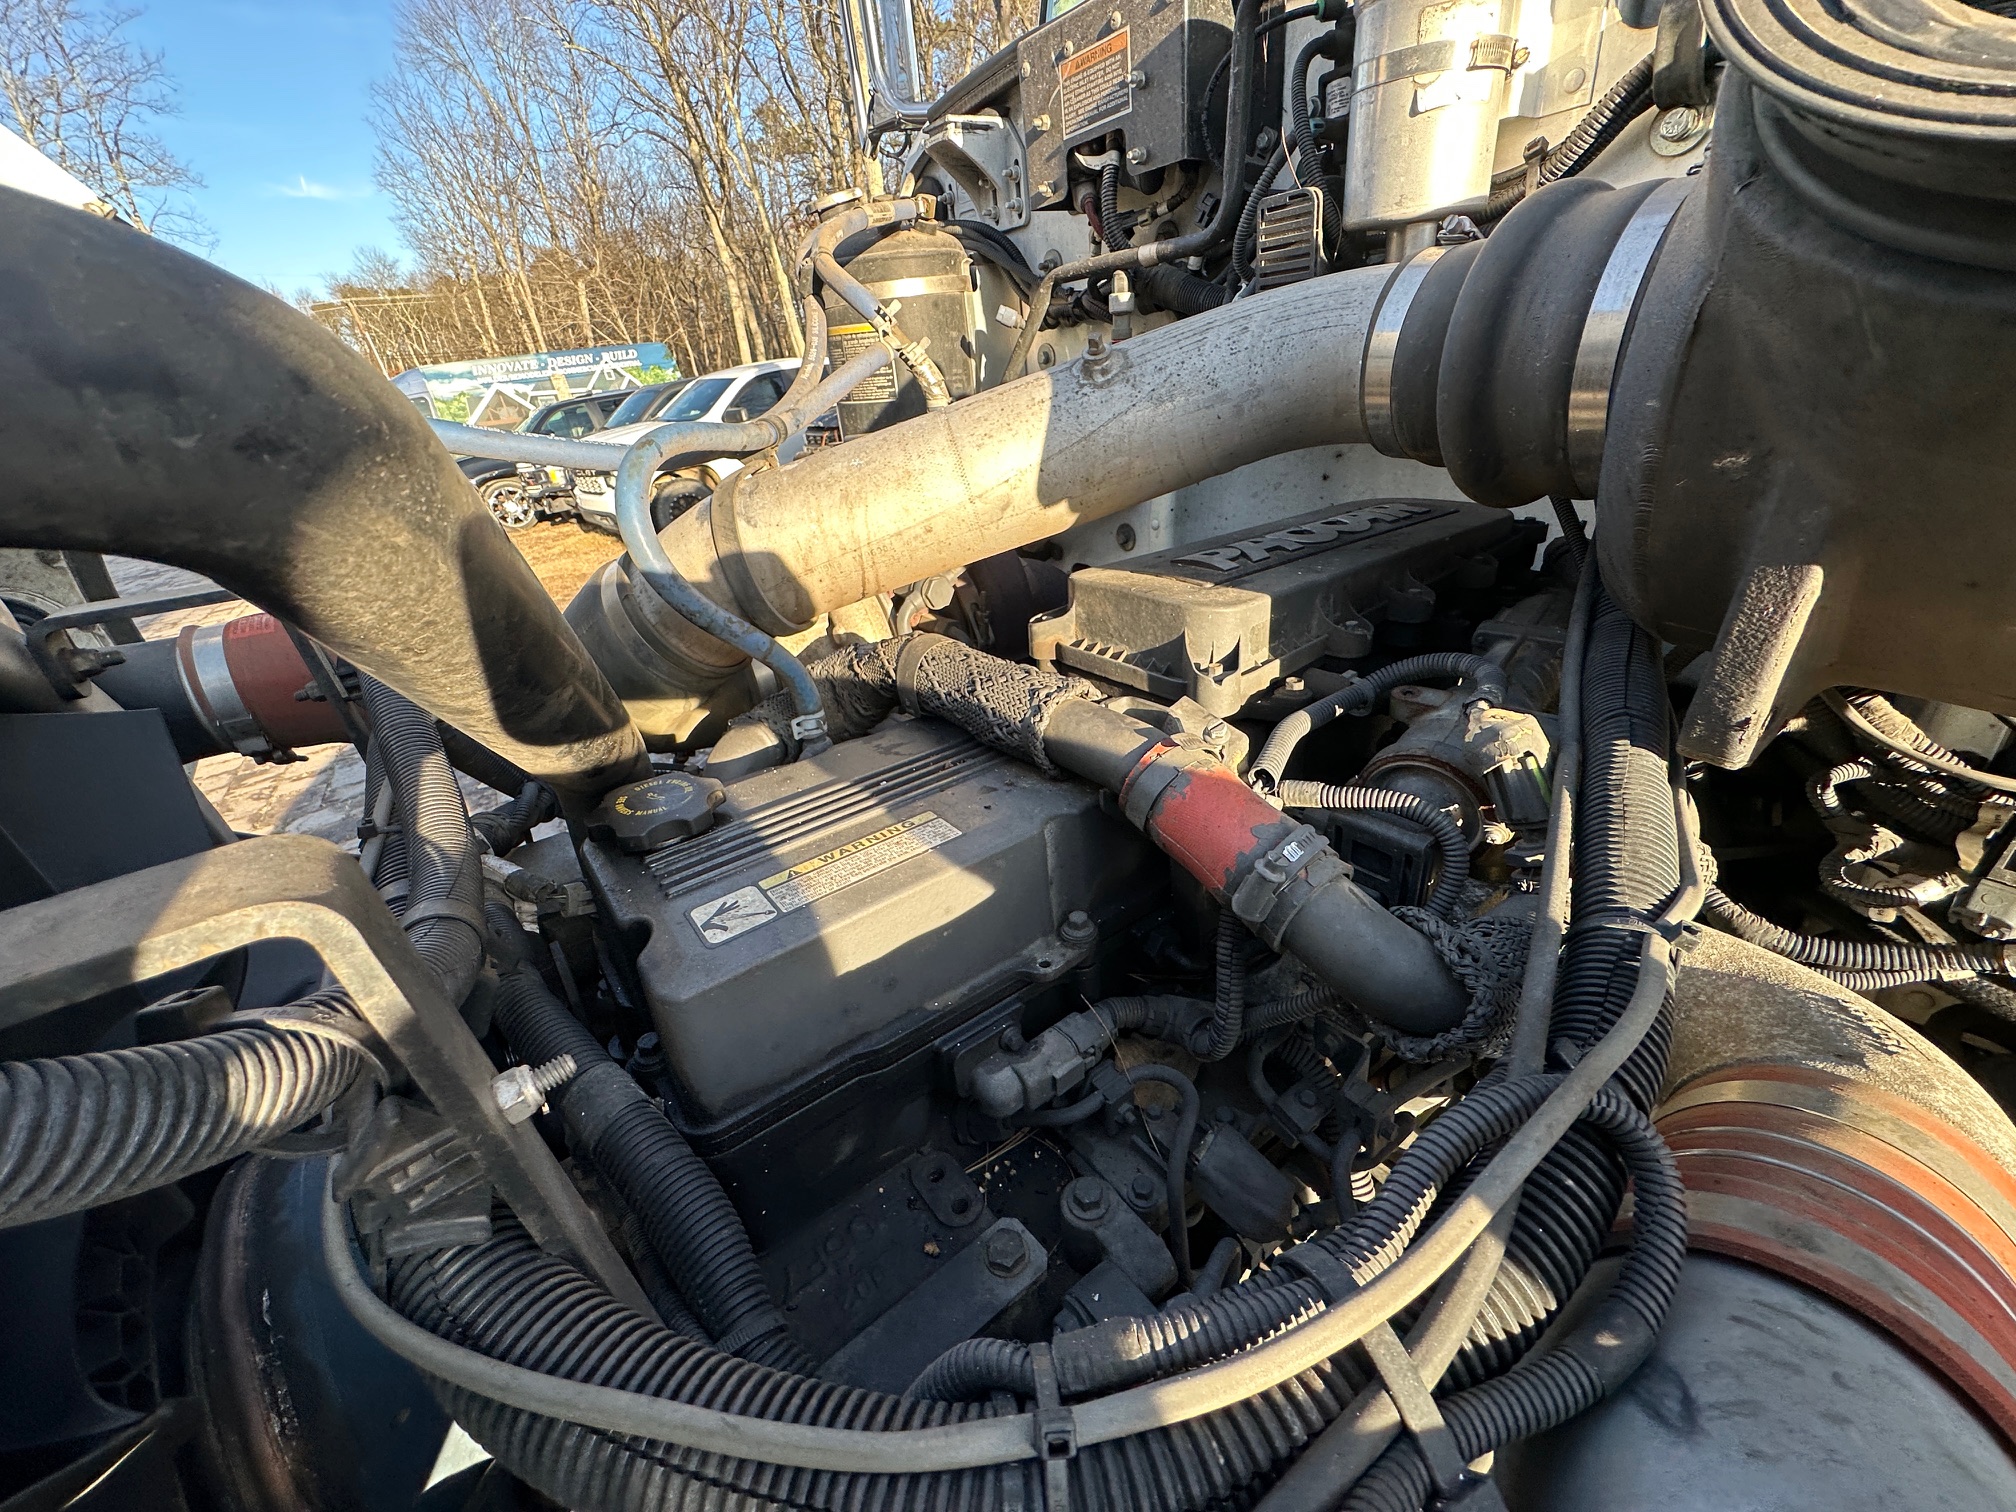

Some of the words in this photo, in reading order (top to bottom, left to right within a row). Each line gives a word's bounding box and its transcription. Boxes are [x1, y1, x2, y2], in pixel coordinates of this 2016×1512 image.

[1081, 43, 1112, 65] WARNING
[472, 358, 539, 376] INNOVATE
[547, 353, 593, 367] DESIGN
[1170, 503, 1431, 572] PACCAR
[634, 780, 662, 792] DIESEL
[635, 806, 668, 816] MANUAL
[818, 820, 916, 864] WARNING
